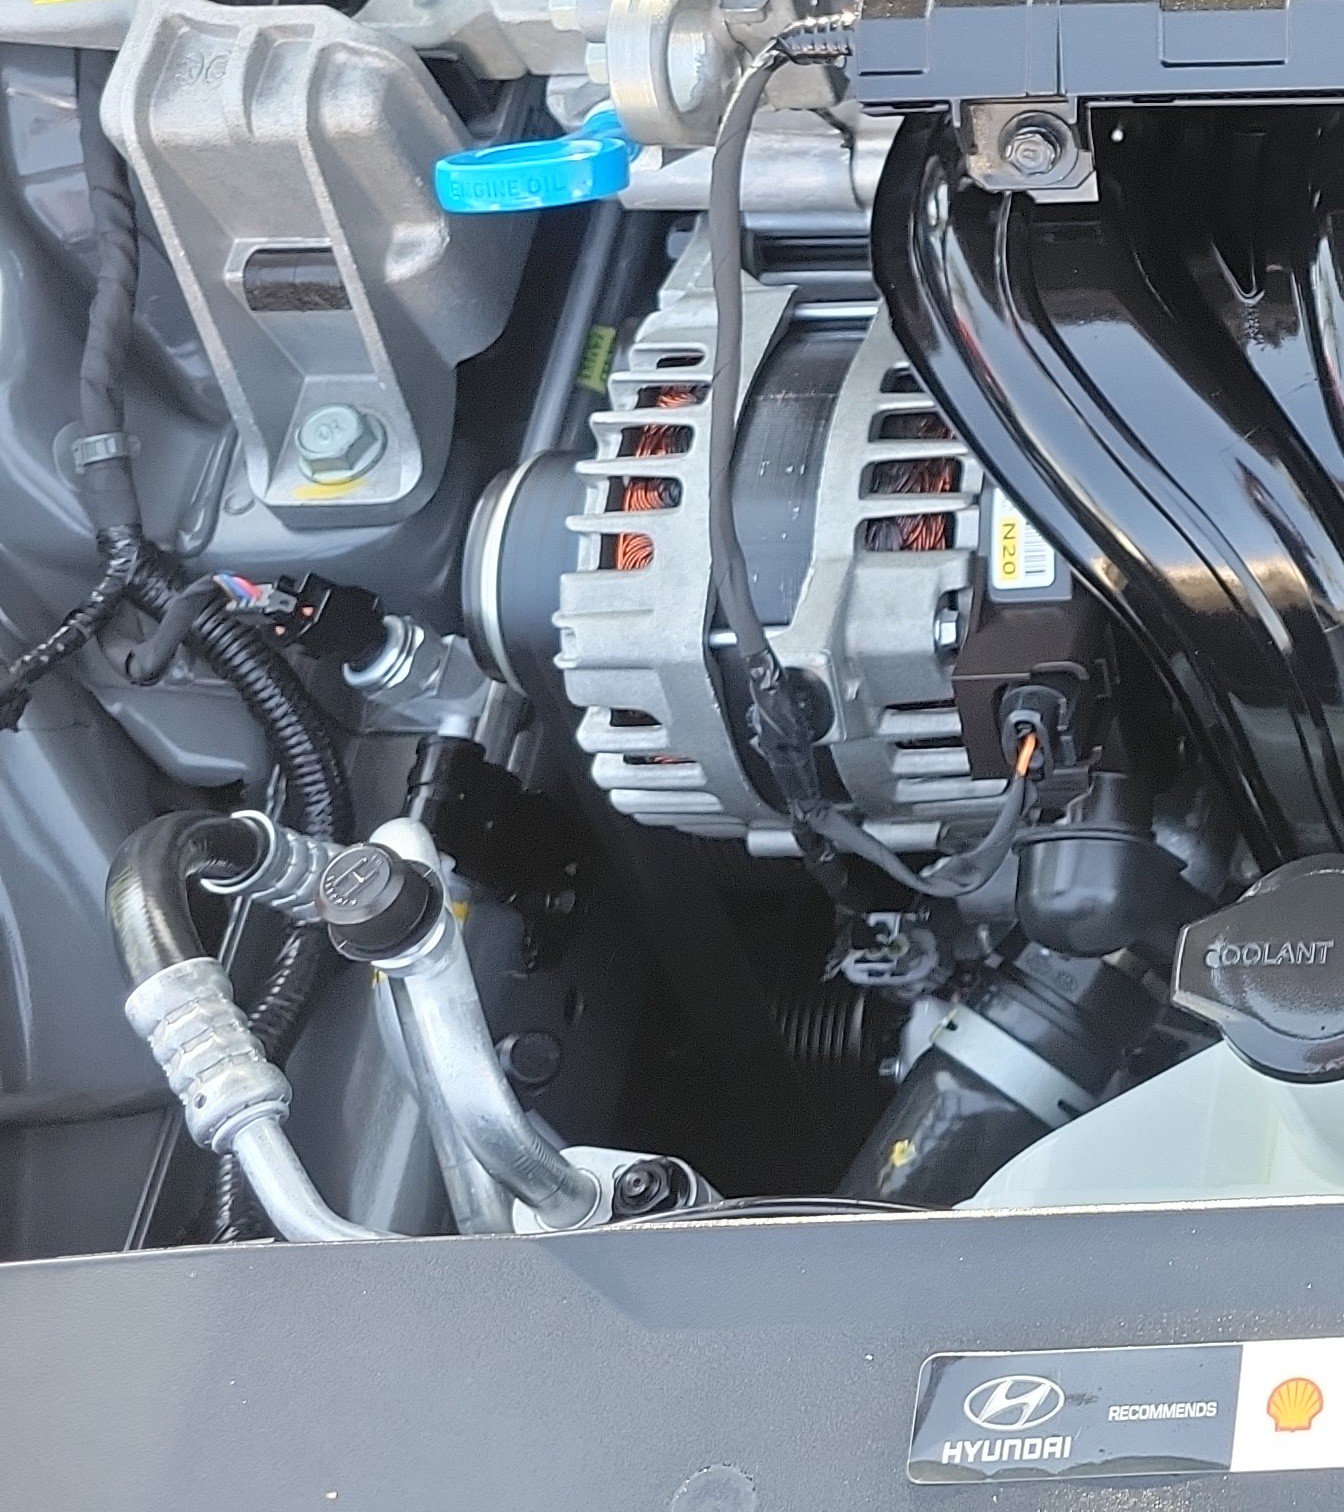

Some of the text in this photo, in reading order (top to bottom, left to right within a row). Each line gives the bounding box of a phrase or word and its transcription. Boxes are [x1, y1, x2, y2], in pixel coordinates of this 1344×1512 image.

[527, 174, 567, 195] OIL
[1204, 939, 1335, 968] COOLANT
[1107, 1401, 1219, 1422] RECOMMENDS
[940, 1435, 1073, 1464] HYUNDAI
